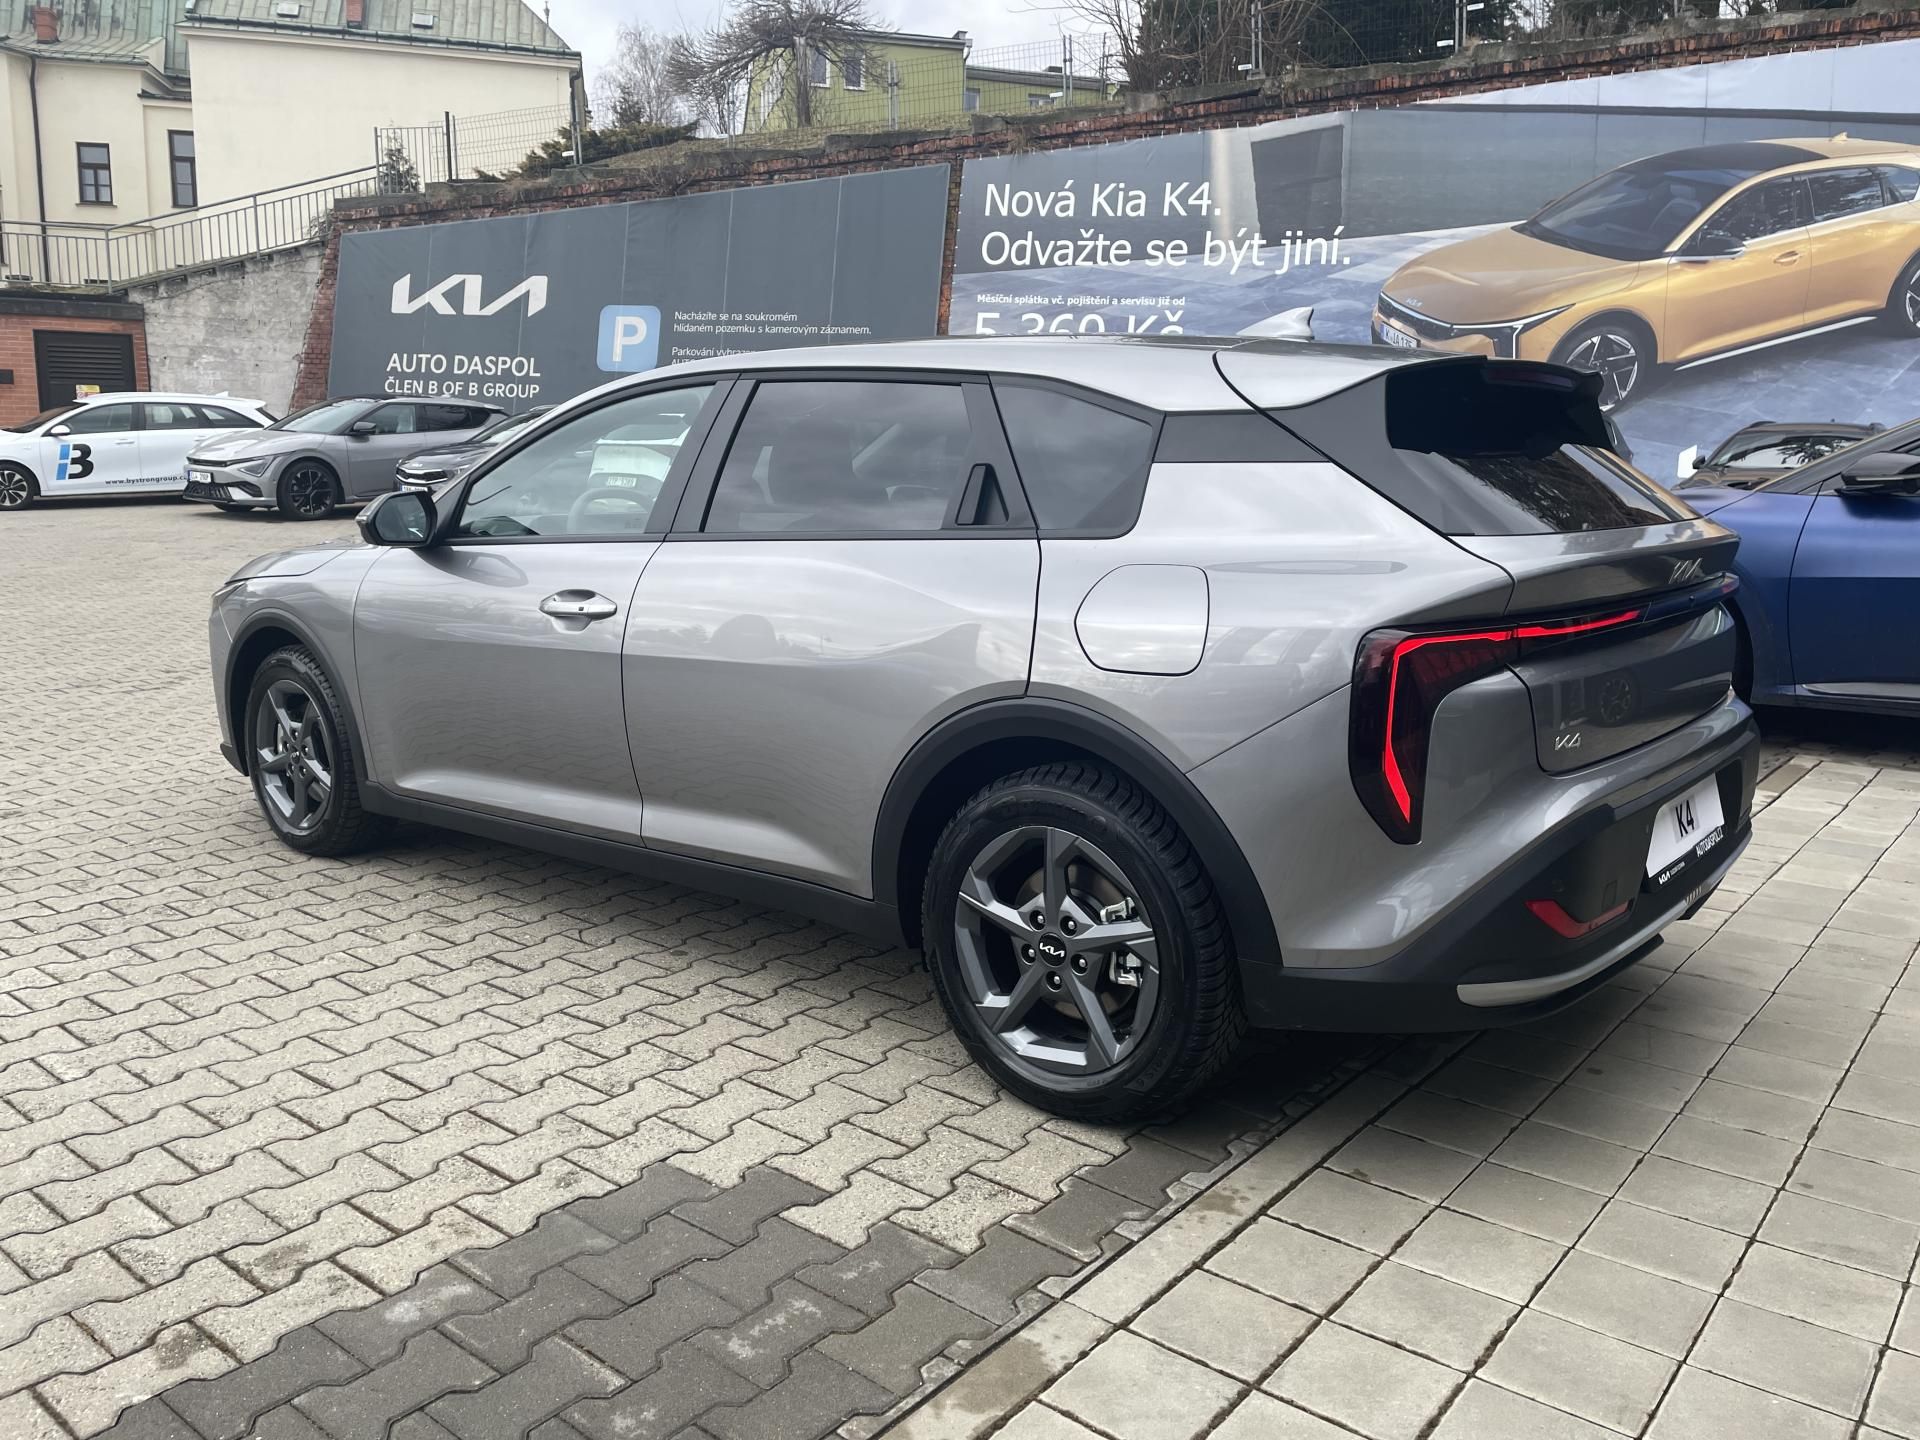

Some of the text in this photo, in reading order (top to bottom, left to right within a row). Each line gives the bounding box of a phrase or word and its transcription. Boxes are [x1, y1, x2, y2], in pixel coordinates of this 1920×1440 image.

[983, 179, 1222, 217] Nová Kia K4.
[981, 225, 1351, 275] Odvažte se být jiní.
[977, 294, 1186, 307] Měsíční splátka vč. pojištění a servisu již od
[674, 311, 717, 321] Nacházíte
[745, 312, 798, 322] soukromém
[612, 315, 647, 362] P
[674, 323, 713, 333] hlídaném
[715, 325, 756, 335] pozemku
[765, 325, 818, 336] kamerovým
[820, 325, 872, 335] záznamem.
[671, 346, 715, 357] Parkování
[386, 353, 541, 377] AUTO DASPOL
[384, 376, 540, 399] ČLEN B OF B GROUP
[1675, 799, 1695, 838] K4
[1039, 942, 1065, 958] KIA
